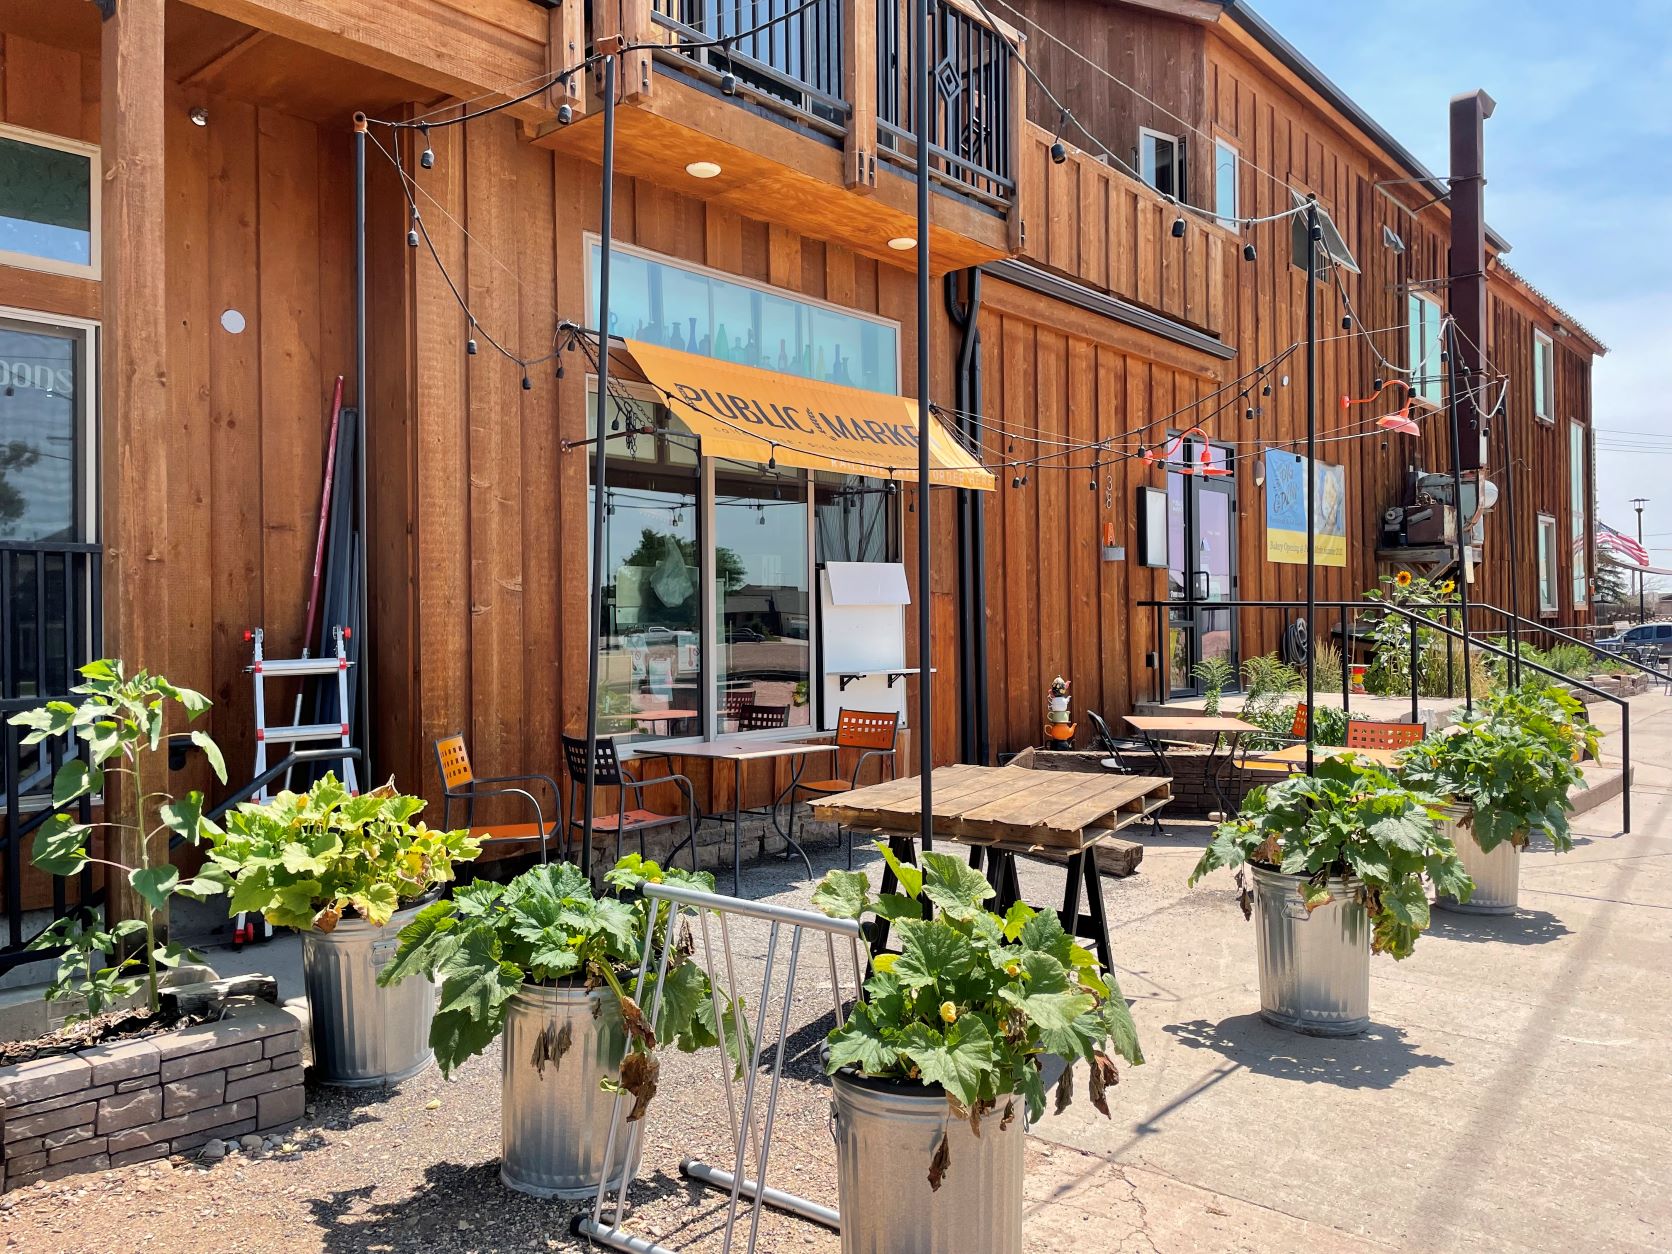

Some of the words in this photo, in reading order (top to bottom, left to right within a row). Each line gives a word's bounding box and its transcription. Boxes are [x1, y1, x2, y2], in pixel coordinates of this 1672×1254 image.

[674, 382, 814, 434] PUBLIC
[818, 412, 941, 449] MARKE
[932, 468, 964, 483] ORDER
[968, 471, 995, 487] HERE
